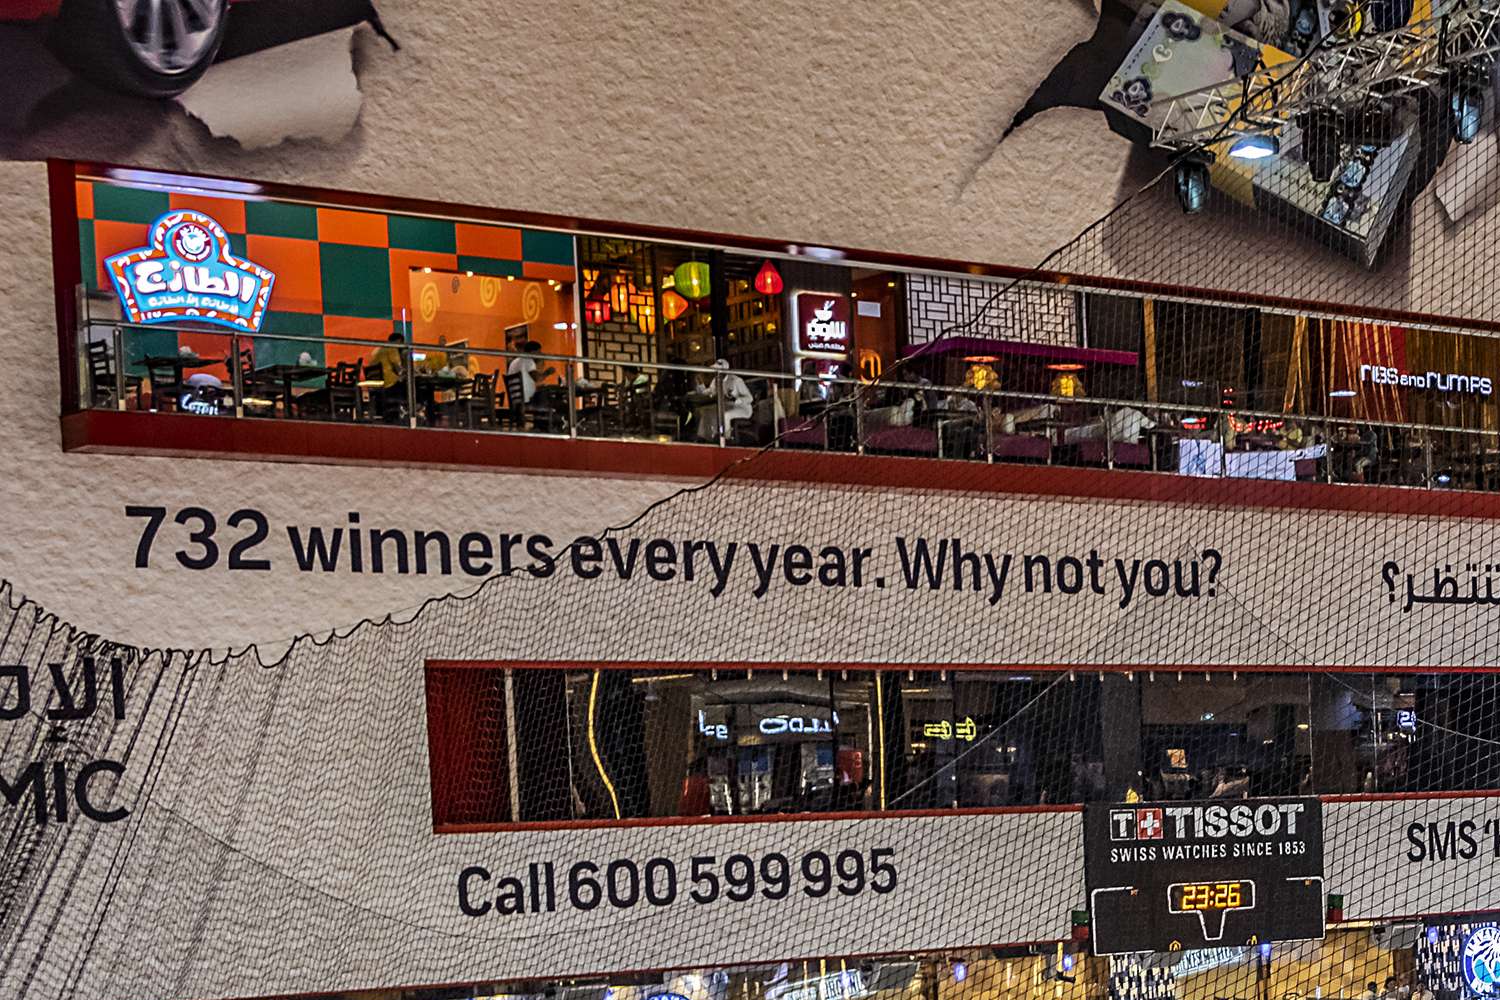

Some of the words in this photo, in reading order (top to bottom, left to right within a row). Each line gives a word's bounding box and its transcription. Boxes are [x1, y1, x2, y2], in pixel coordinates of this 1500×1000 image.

[134, 260, 258, 304] الطازج
[126, 505, 271, 571] 732
[287, 522, 556, 578] winners
[569, 535, 736, 596] every
[751, 540, 887, 594] year.
[897, 537, 1012, 603] Why
[1024, 548, 1101, 596] not
[1117, 549, 1223, 600] you?
[1165, 804, 1305, 839] TISSOT
[1406, 820, 1478, 862] SMS
[1110, 847, 1156, 862] SWISS
[1162, 844, 1227, 860] WATCHES
[1233, 841, 1273, 856] SINCE
[1278, 841, 1306, 855] 1853
[457, 861, 556, 917] Call
[567, 857, 677, 911] 600
[690, 852, 791, 904] 599
[801, 847, 899, 898] 995
[1181, 883, 1241, 910] 23:26
